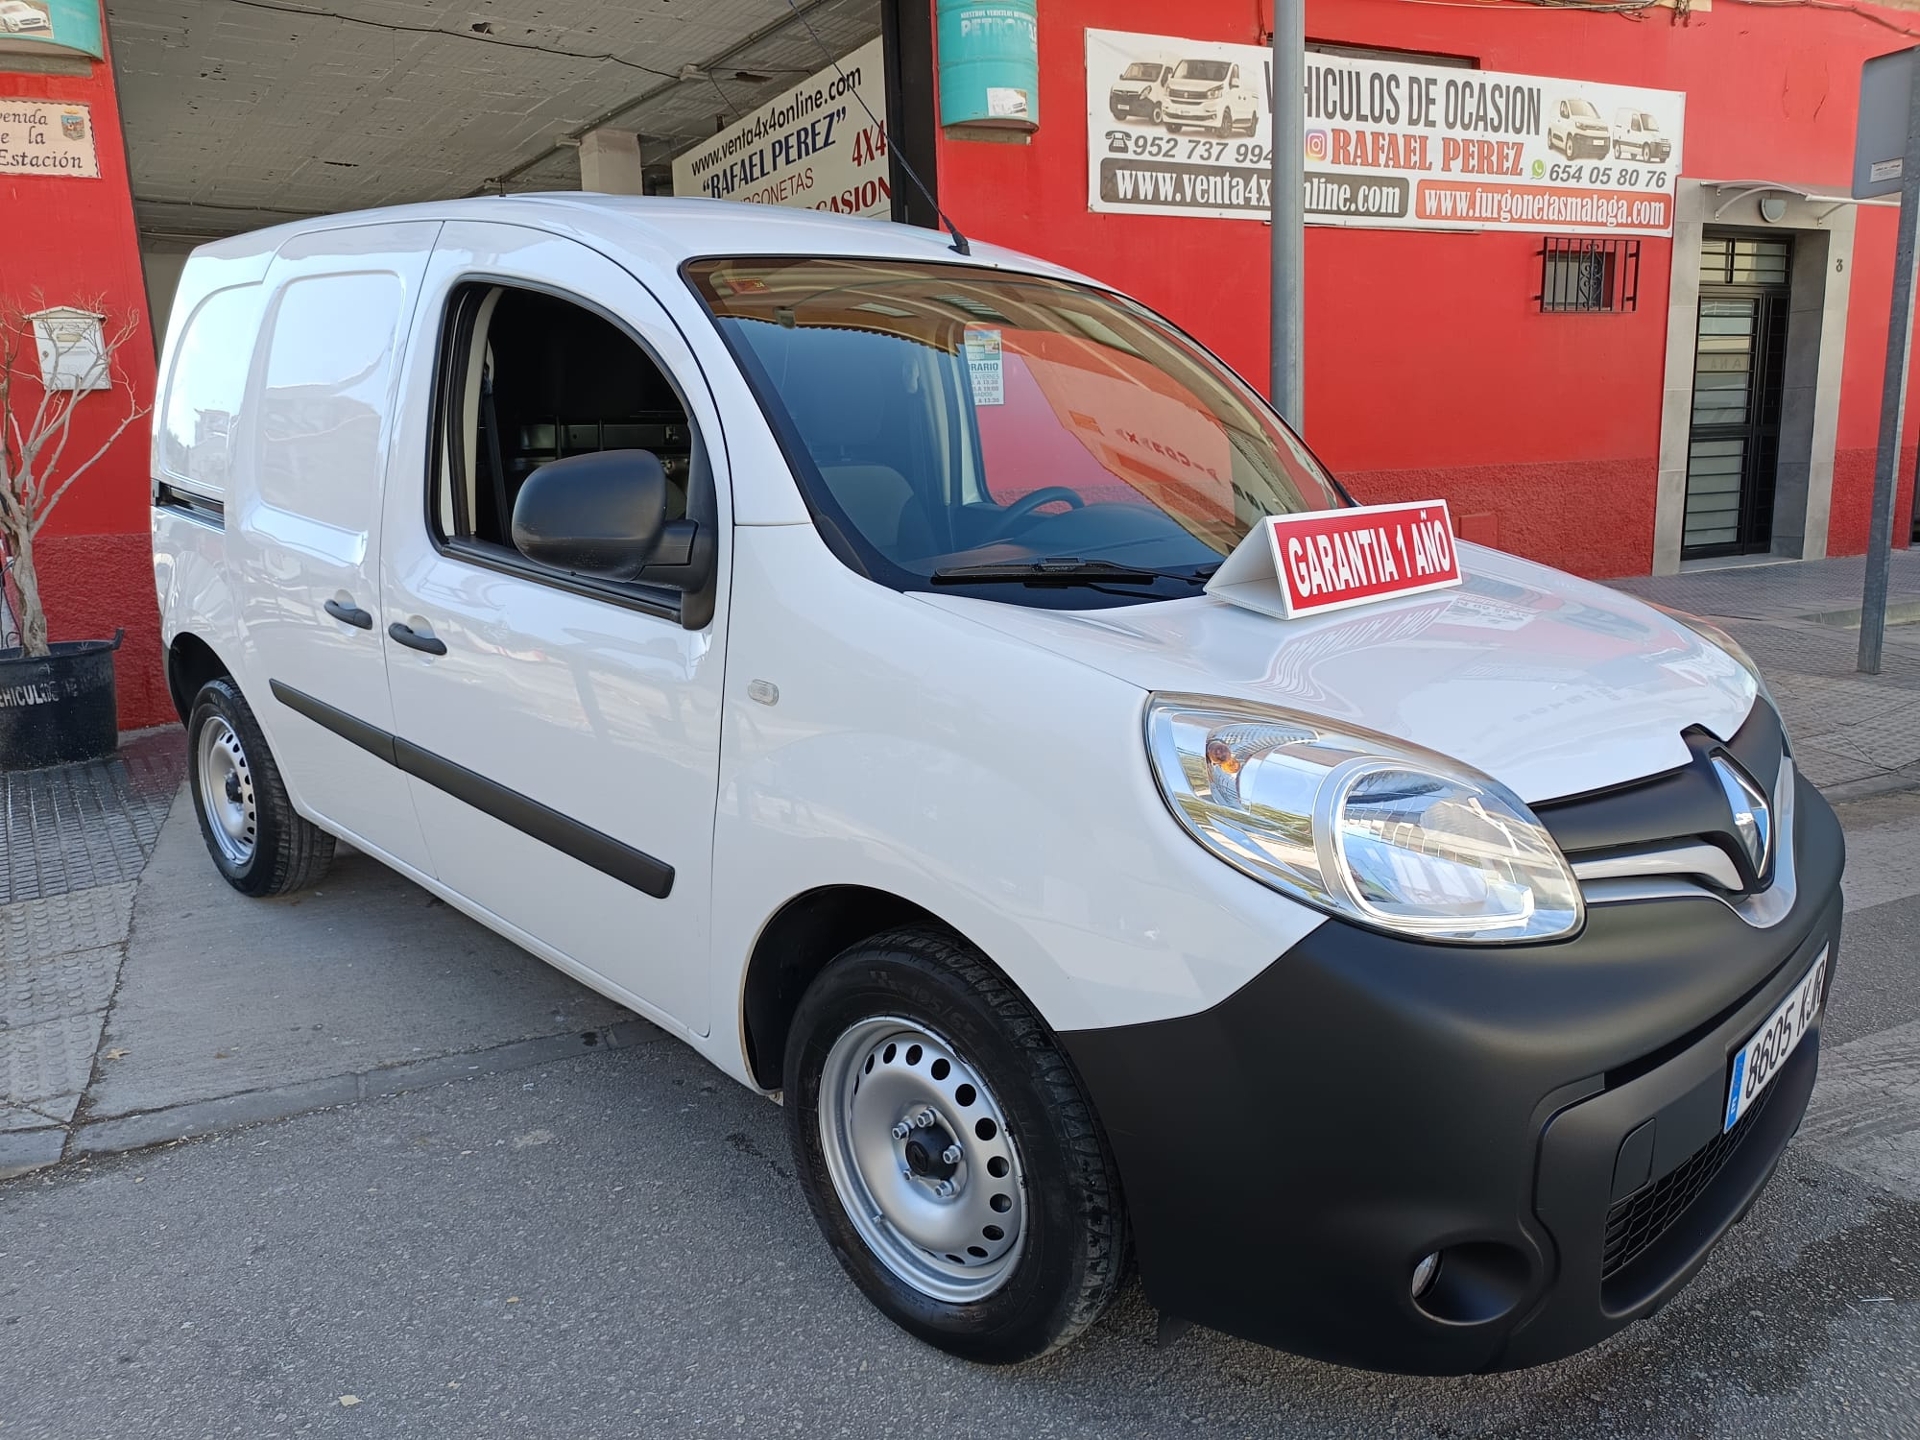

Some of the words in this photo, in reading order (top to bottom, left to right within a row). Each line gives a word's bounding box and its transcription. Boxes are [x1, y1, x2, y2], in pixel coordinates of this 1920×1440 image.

[1264, 60, 1400, 126] VHICULOS
[1407, 76, 1438, 128] DE
[1444, 79, 1541, 136] OCASION
[0, 108, 48, 126] enida
[0, 131, 10, 144] e
[28, 125, 46, 145] la
[690, 66, 862, 176] www.venta4x4online.com
[0, 149, 83, 169] Estación
[1132, 134, 1179, 159] 952
[1186, 139, 1229, 162] 737
[1331, 128, 1433, 171] RAFAEL
[1441, 137, 1524, 176] PEREZ
[740, 167, 814, 204] GONETAS
[1115, 169, 1400, 214] www.venta4xnline.com
[1549, 163, 1583, 184] 654
[1589, 167, 1612, 185] 05
[1616, 168, 1640, 187] 80
[1644, 170, 1667, 188] 76
[1424, 186, 1665, 227] www.furgonetasmalaga.com
[1835, 258, 1844, 272] 3
[970, 362, 999, 371] RARIO
[1287, 525, 1399, 598] GARANTIA
[1396, 524, 1412, 578] 1
[1411, 509, 1451, 577] AÑO
[1745, 1001, 1796, 1100] 8605
